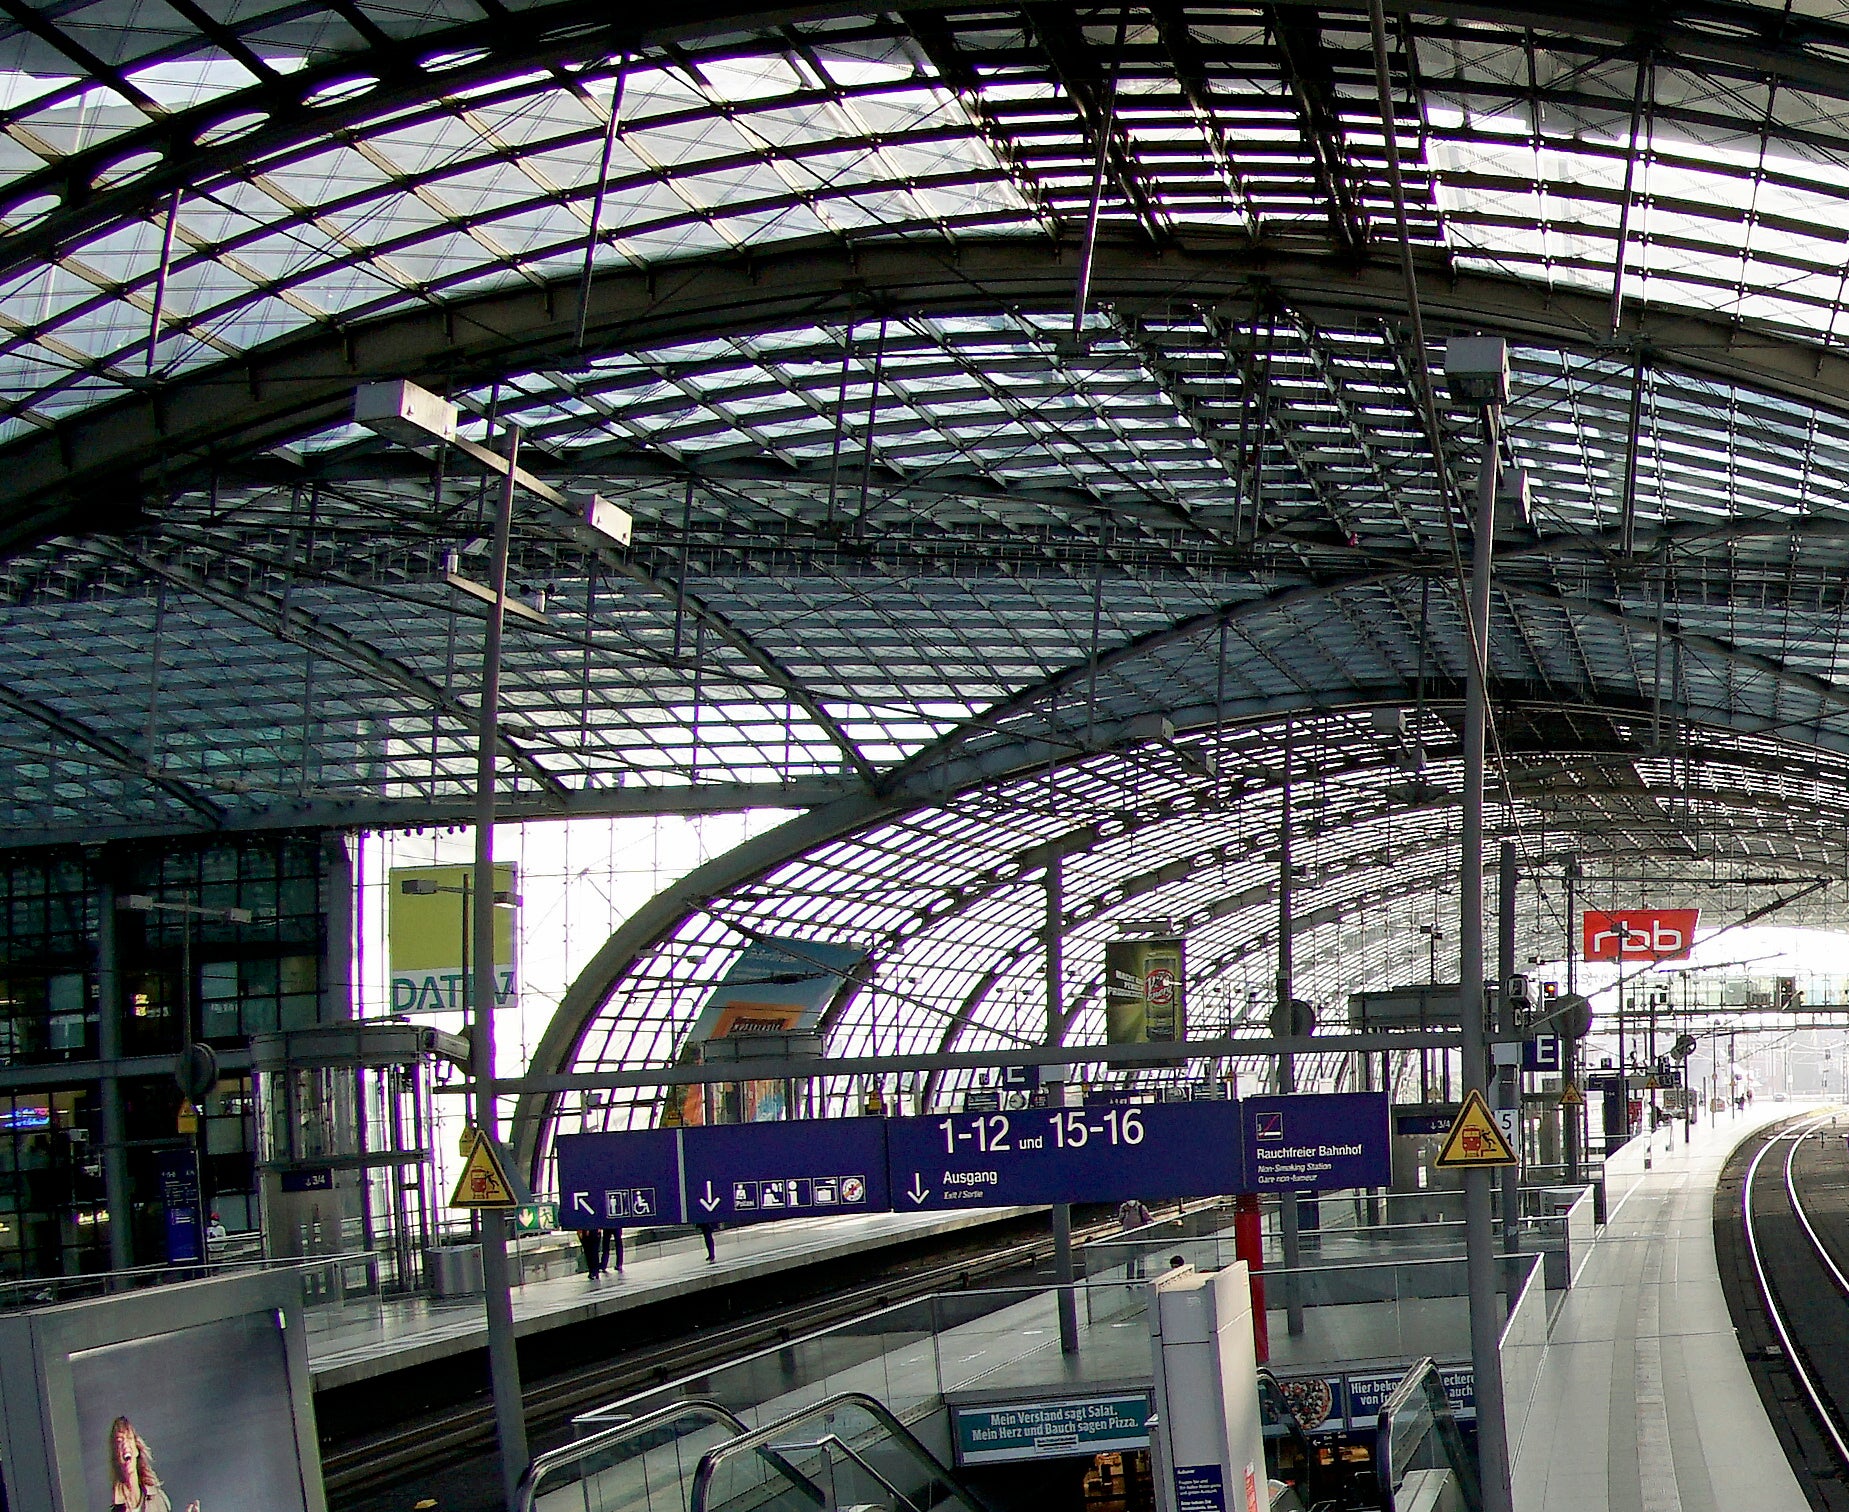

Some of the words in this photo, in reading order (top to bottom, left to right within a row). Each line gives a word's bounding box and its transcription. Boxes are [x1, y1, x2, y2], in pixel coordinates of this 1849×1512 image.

[1594, 920, 1682, 952] rbb
[1536, 1034, 1555, 1063] E
[939, 1115, 1011, 1154] 1-12
[1019, 1136, 1043, 1150] und
[1049, 1108, 1145, 1148] 15-16
[1502, 1113, 1511, 1130] 5
[1257, 1147, 1316, 1160] Rauchfreier
[1318, 1144, 1362, 1157] Bahnhof
[943, 1171, 998, 1186] Ausgang
[1351, 1381, 1371, 1394] Hier
[1361, 1395, 1378, 1406] von
[1449, 1387, 1474, 1398] auch
[991, 1413, 1016, 1427] Mein
[1017, 1408, 1063, 1424] Verstand
[1064, 1406, 1087, 1422] sagt
[1088, 1404, 1118, 1418] Salat.
[972, 1428, 998, 1442] Mein
[999, 1425, 1022, 1439] Herz
[1023, 1424, 1043, 1437] und
[1044, 1420, 1076, 1435] Bauch
[1077, 1419, 1107, 1434] sagen
[1108, 1416, 1138, 1430] Pizza.
